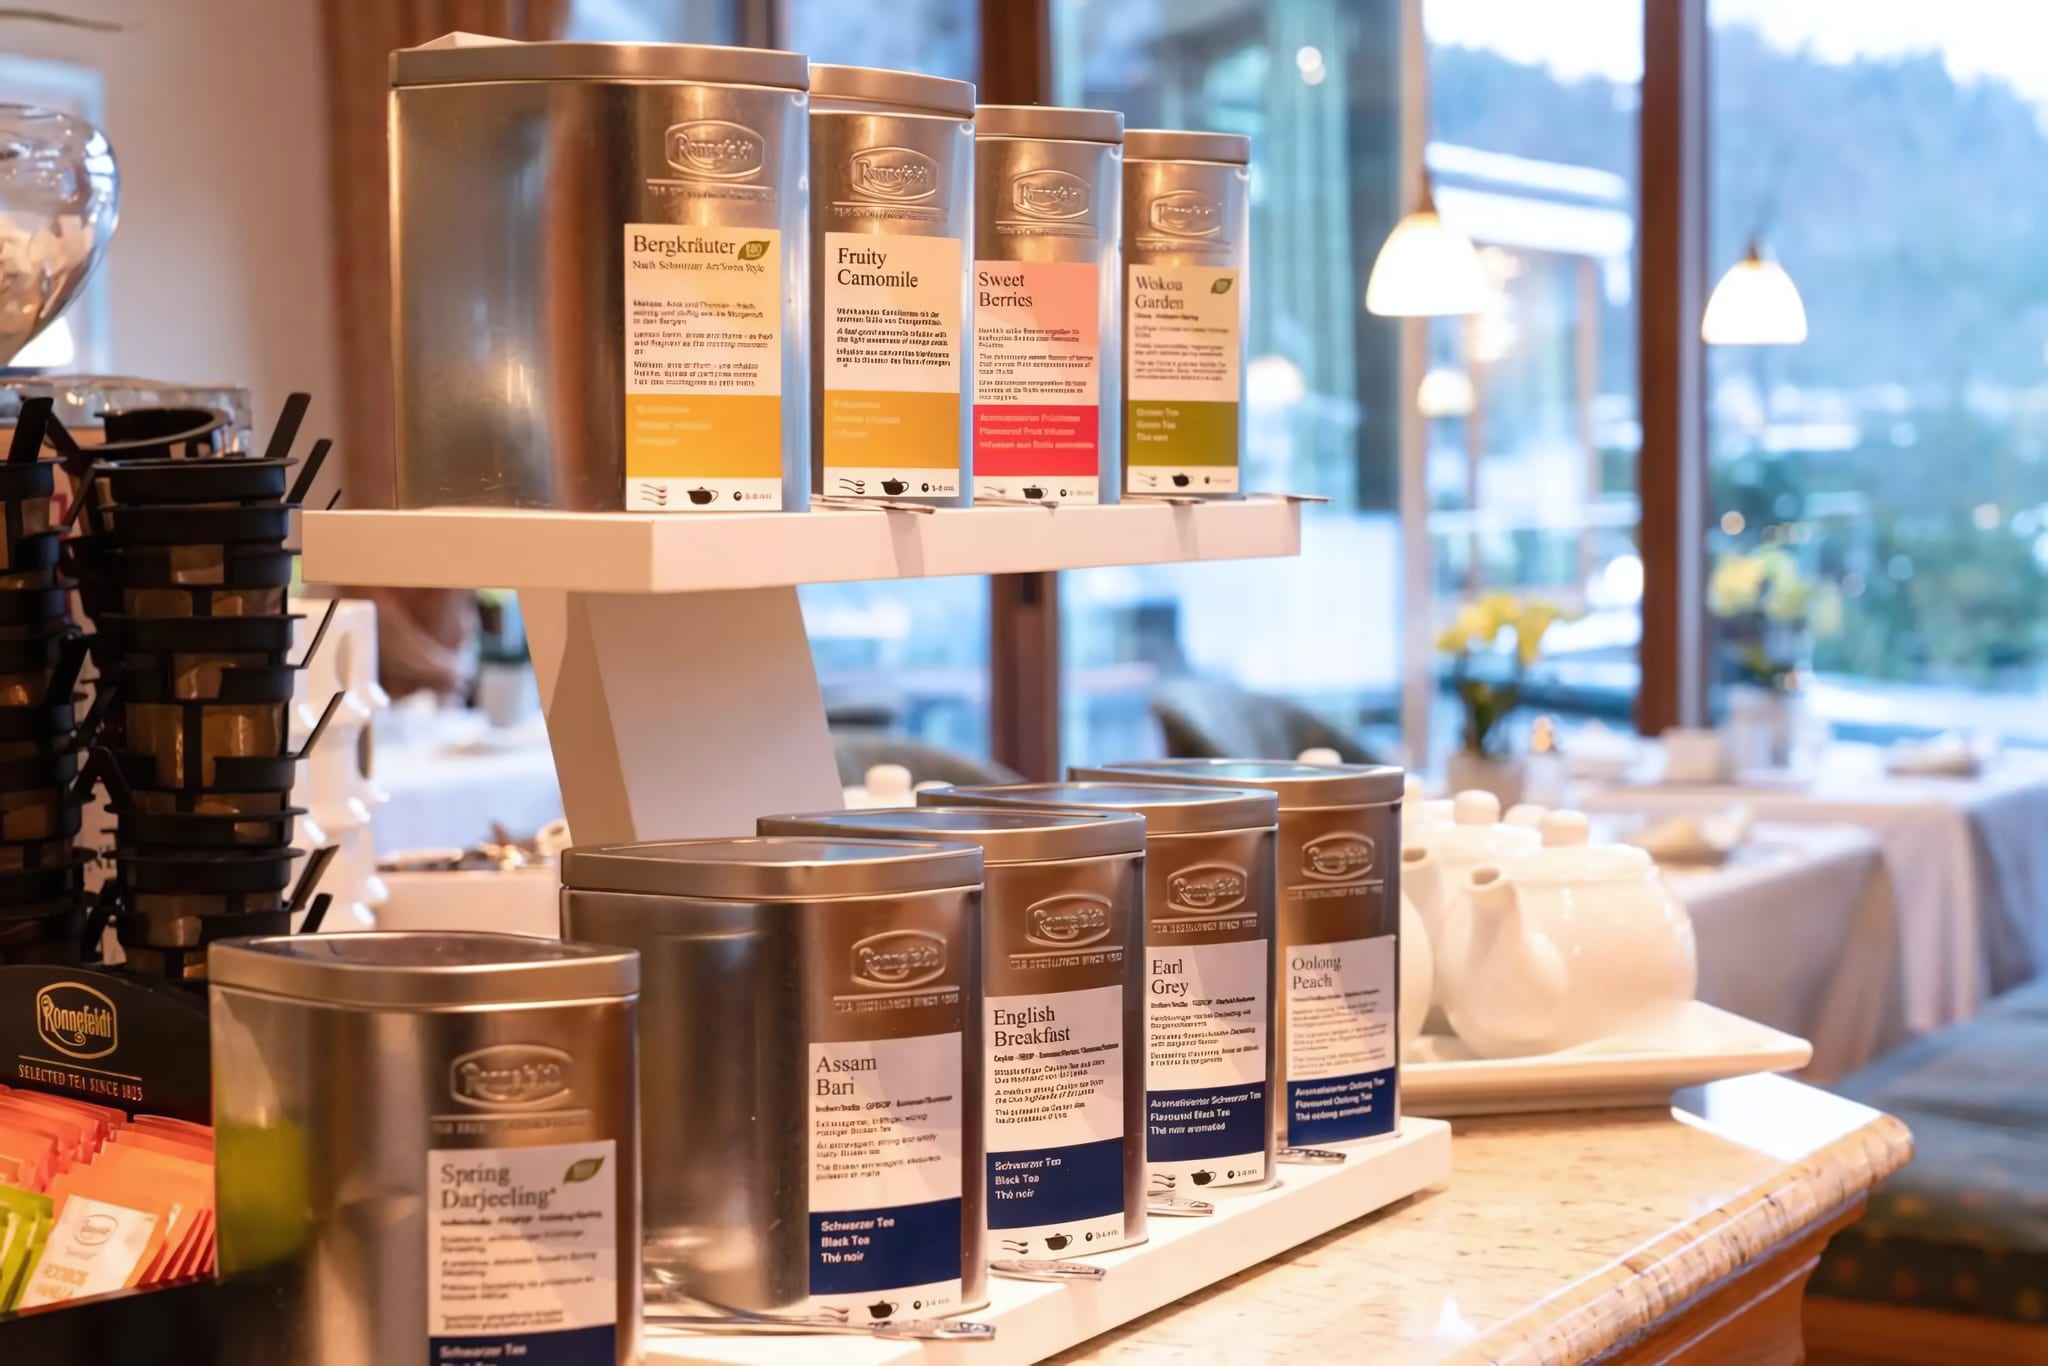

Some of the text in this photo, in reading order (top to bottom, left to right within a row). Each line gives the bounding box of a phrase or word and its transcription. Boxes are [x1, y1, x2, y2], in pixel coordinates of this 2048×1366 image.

[633, 234, 737, 257] Bergkräuter
[837, 247, 887, 269] Fruity
[837, 268, 919, 288] Camomile
[978, 271, 1025, 287] Sweet
[979, 291, 1033, 307] Berries
[1135, 294, 1184, 310] Garden
[1152, 958, 1182, 975] Earl
[1292, 955, 1342, 971] Oolong
[1151, 979, 1189, 997] Grey
[1293, 974, 1332, 990] Peach
[41, 994, 112, 1046] Ronnefeldt
[993, 1005, 1055, 1029] English
[994, 1026, 1071, 1047] Breakfast
[816, 1055, 877, 1073] Assam
[18, 1064, 66, 1086] SELECTED
[90, 1078, 119, 1096] SINCE
[816, 1076, 855, 1096] Bari
[994, 1160, 1044, 1171] Schwarzer
[440, 1163, 510, 1187] Spring
[994, 1175, 1020, 1185] Black
[821, 1217, 895, 1232] Schwarzer Tee
[821, 1234, 871, 1248] Black Tea
[821, 1251, 865, 1264] Thé noir
